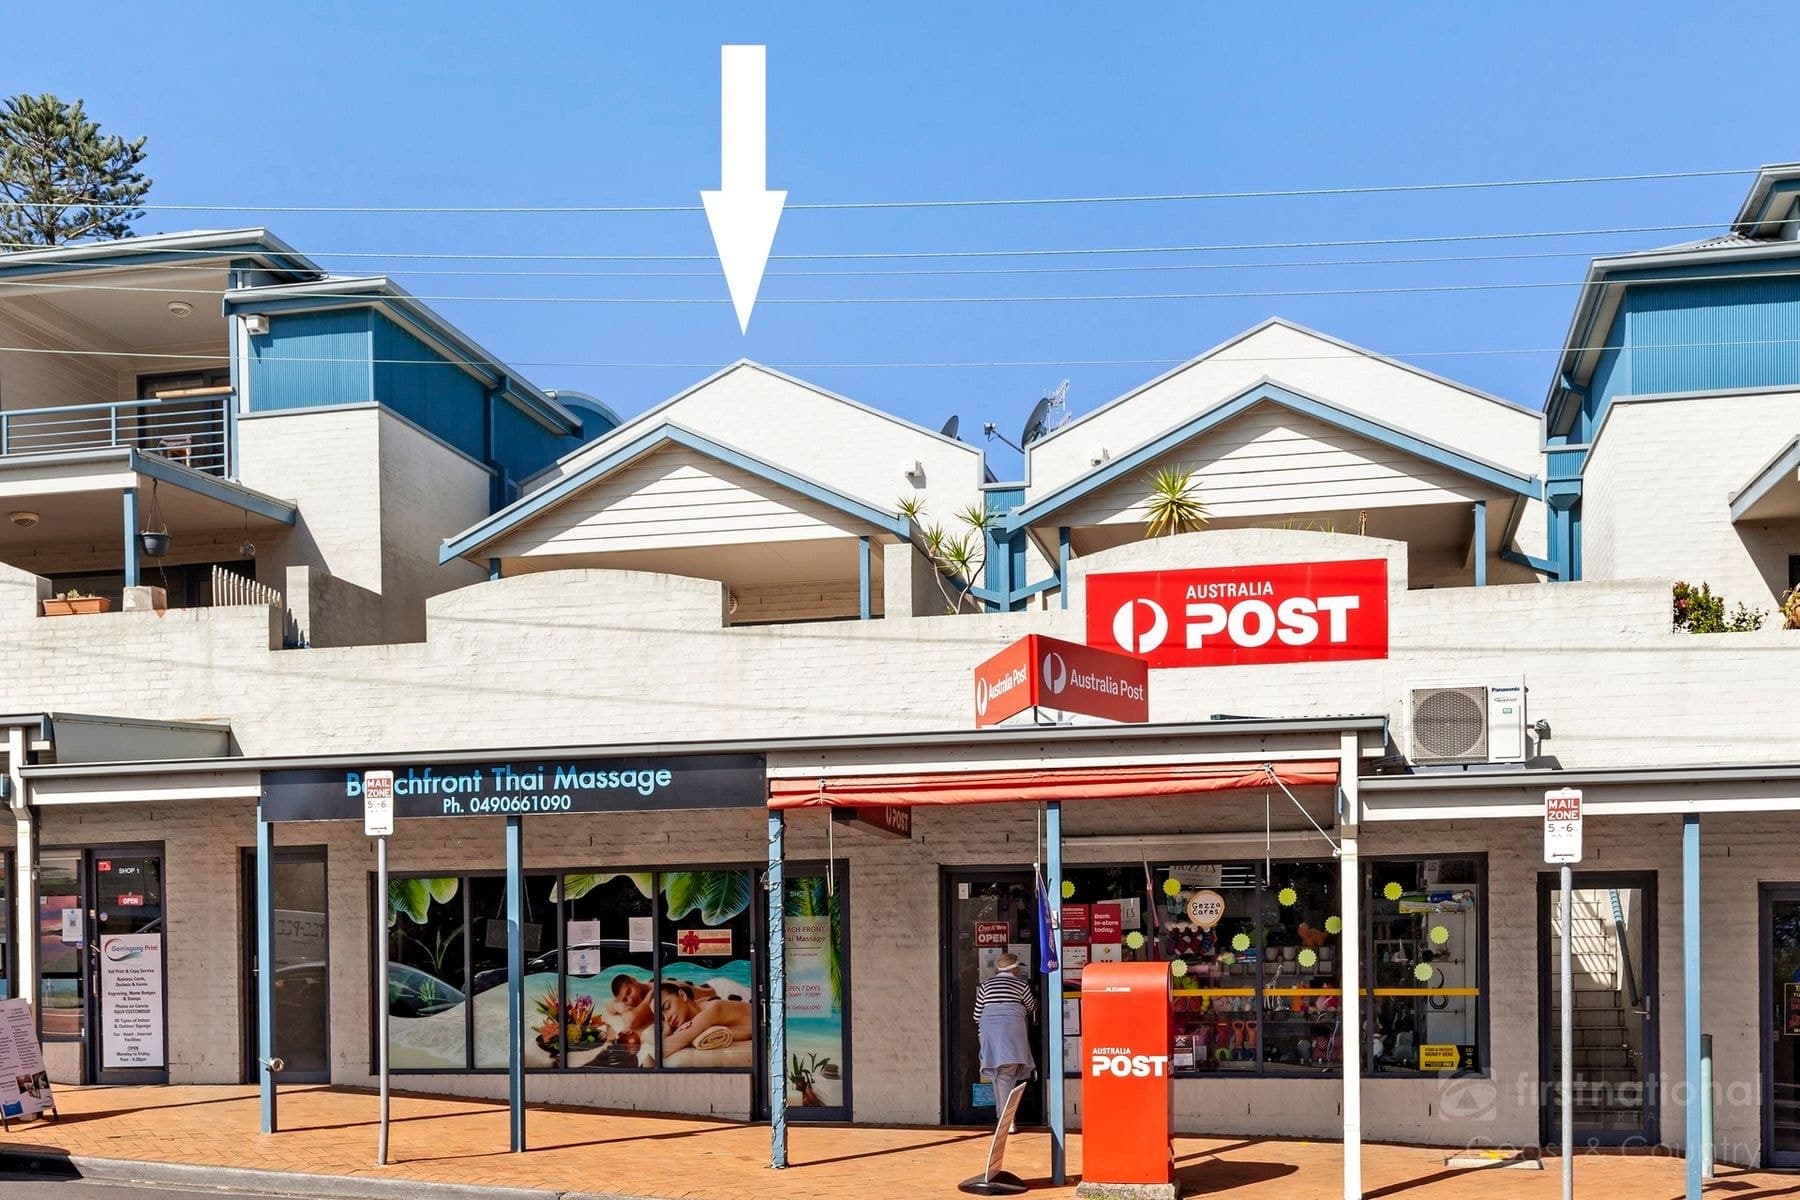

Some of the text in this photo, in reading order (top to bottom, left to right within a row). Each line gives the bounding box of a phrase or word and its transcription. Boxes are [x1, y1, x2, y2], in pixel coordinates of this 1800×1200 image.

[1186, 581, 1274, 599] AUSTRALIA
[1186, 595, 1360, 650] POST
[988, 663, 1027, 701] Australia Post
[1070, 669, 1144, 701] Australia Post
[346, 764, 672, 797] Bchfront Thai Massage
[367, 778, 391, 788] MAIL
[367, 789, 390, 798] ZONE
[443, 794, 571, 814] Ph. 0490661090
[1548, 799, 1579, 809] MAIL
[892, 807, 909, 832] POST
[1548, 810, 1579, 820] ZONE
[796, 935, 826, 943] Massage
[978, 933, 1007, 943] OPEN
[1092, 1047, 1132, 1055] AUSTRALIA
[1092, 1055, 1168, 1077] POST
